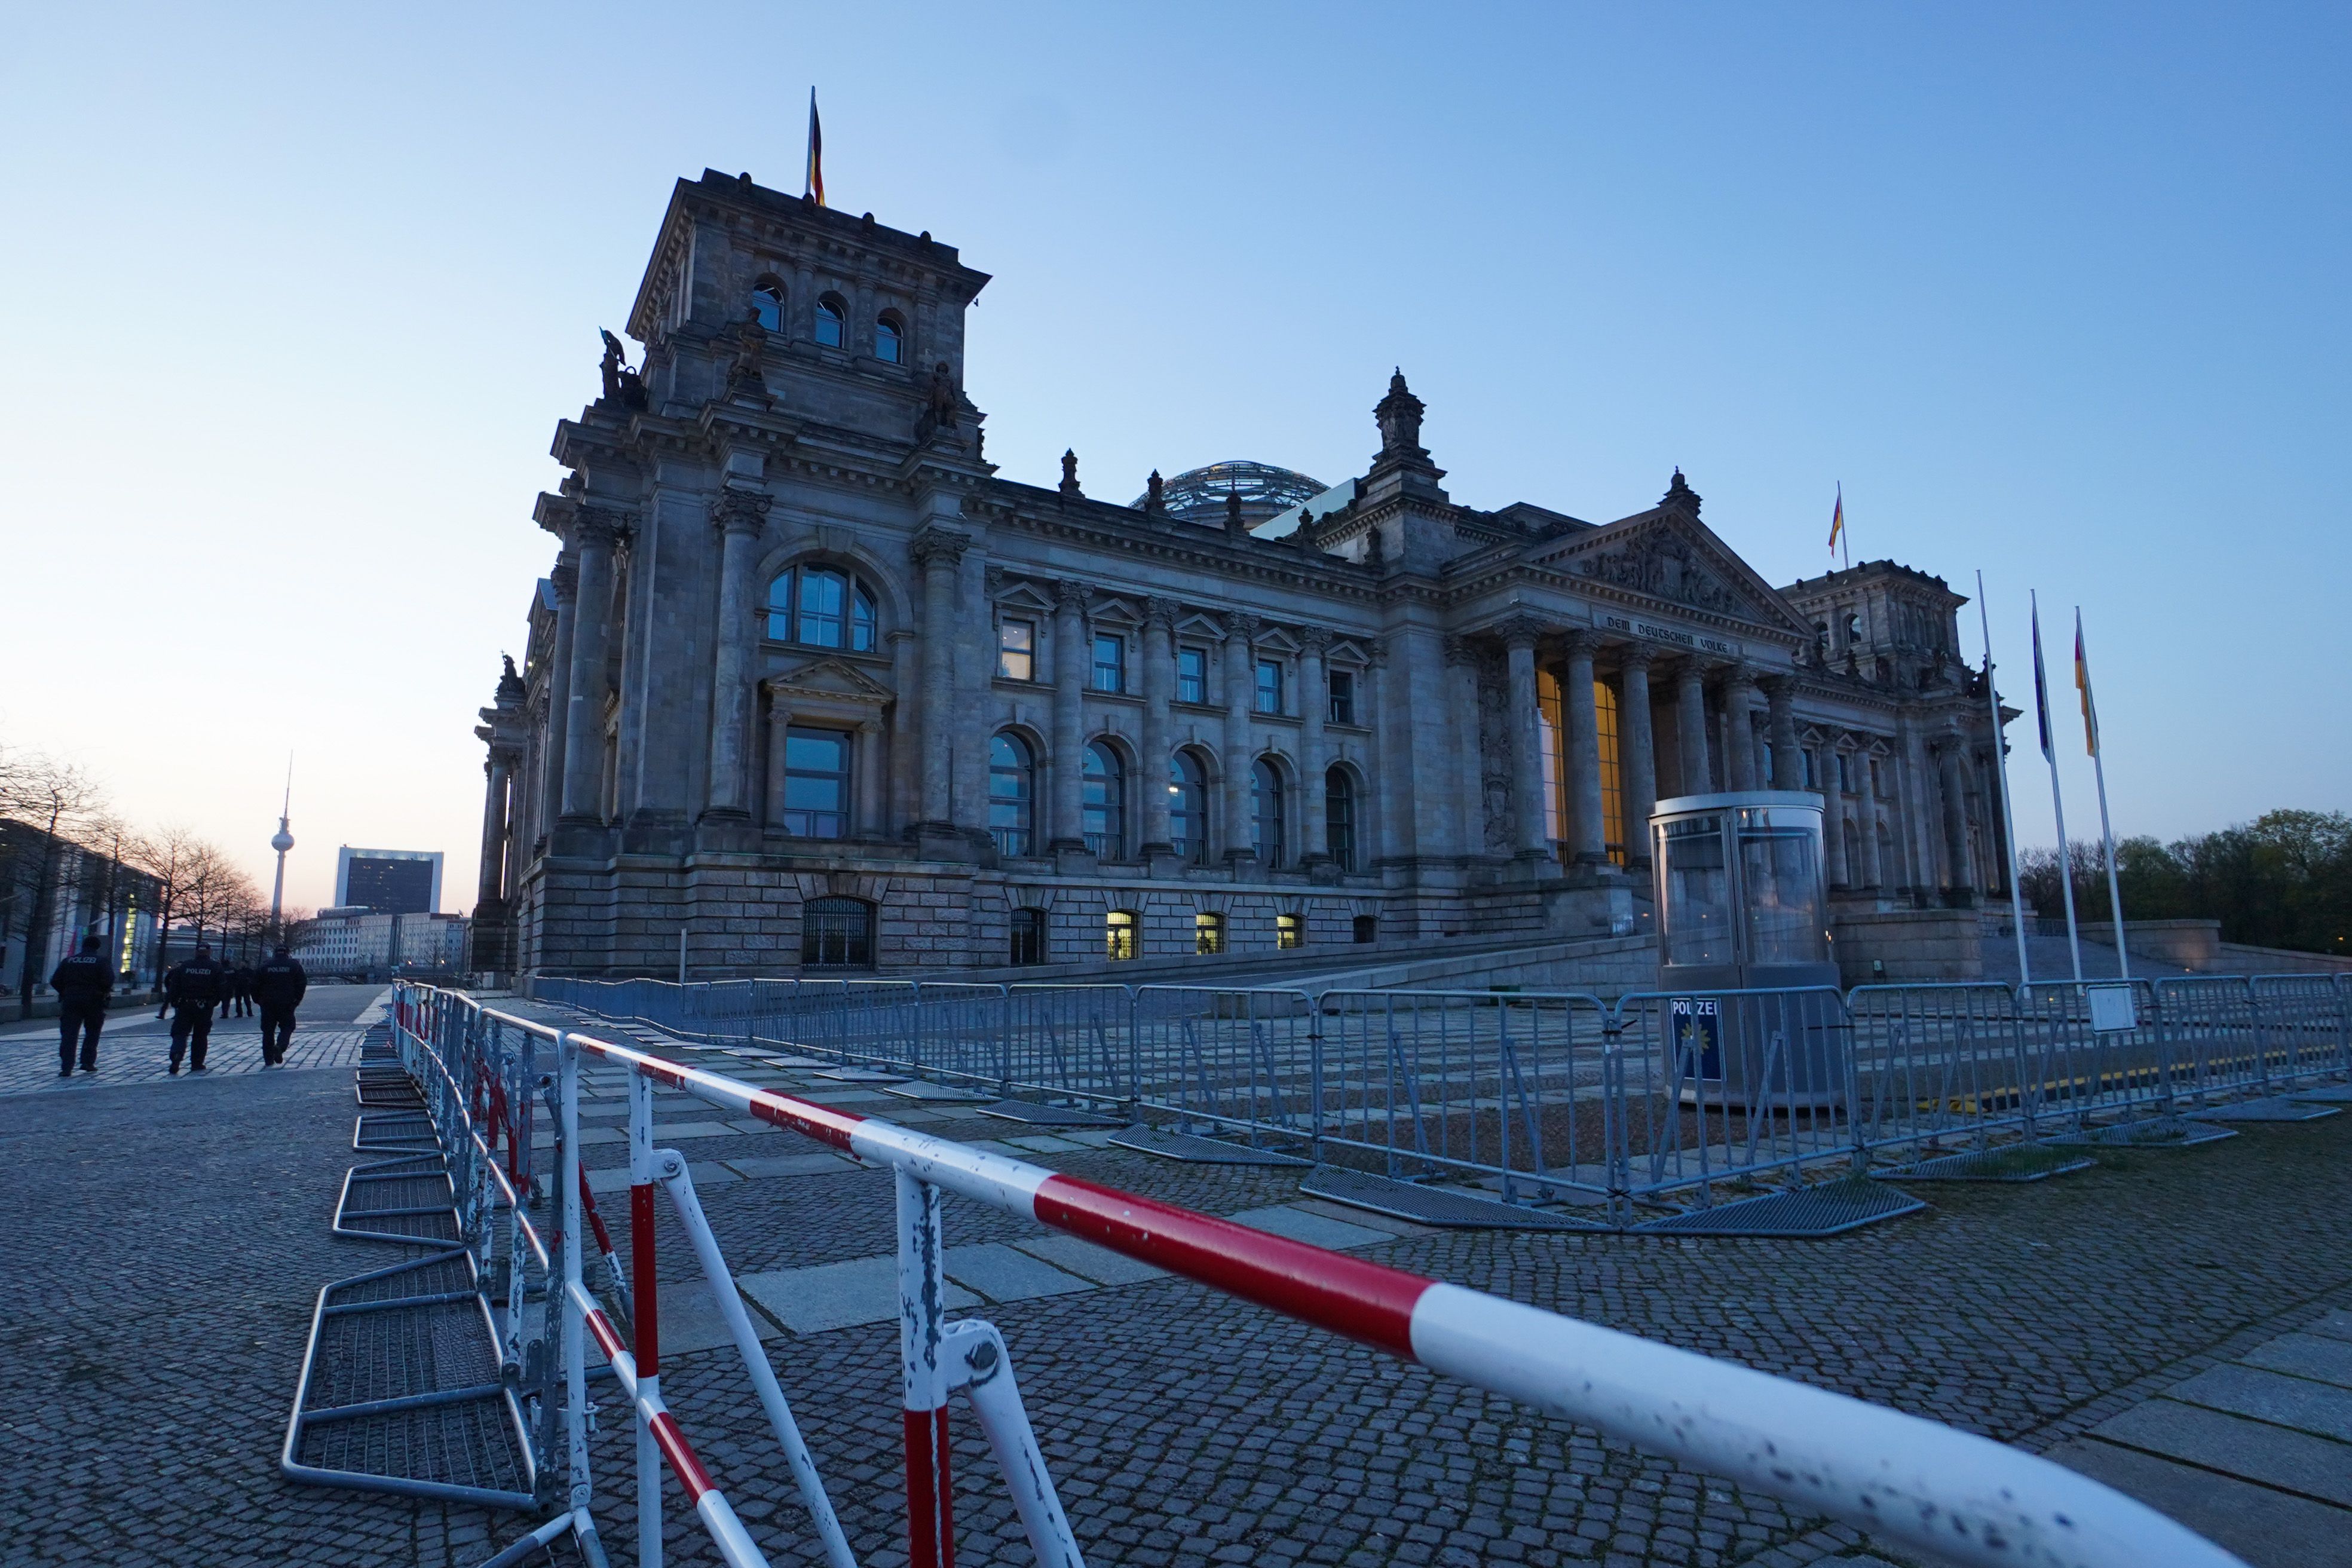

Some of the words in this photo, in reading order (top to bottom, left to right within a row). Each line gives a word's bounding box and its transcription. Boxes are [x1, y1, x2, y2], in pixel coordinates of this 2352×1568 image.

[1607, 617, 1630, 631] DEM
[1638, 624, 1693, 645] DEUTSCHEN
[1700, 638, 1728, 653] VOLKE
[1673, 1002, 1717, 1015] POLZEI
